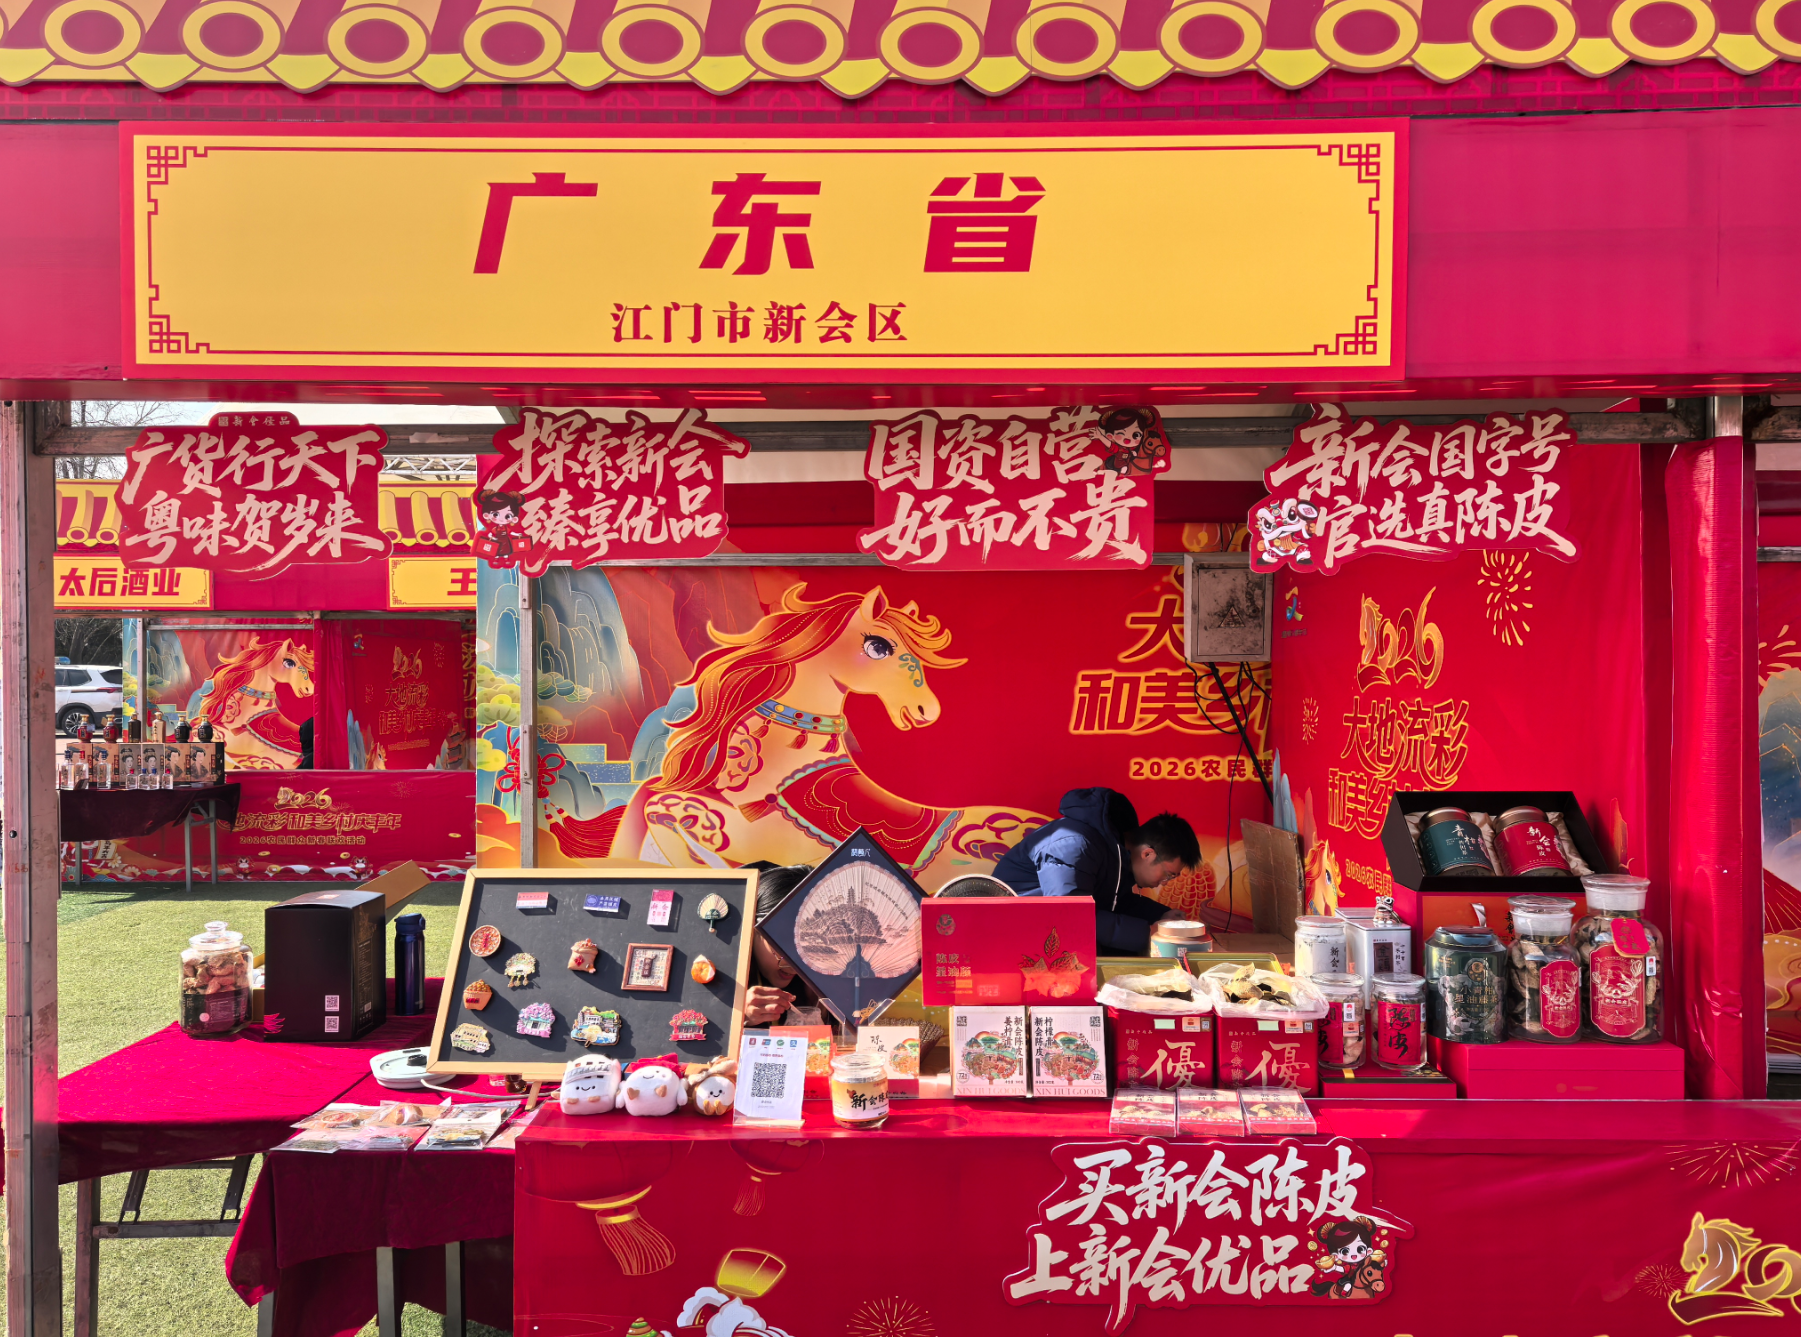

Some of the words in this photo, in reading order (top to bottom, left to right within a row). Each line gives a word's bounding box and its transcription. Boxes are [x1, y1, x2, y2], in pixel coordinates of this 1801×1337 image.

[473, 172, 1046, 275] 广东省
[611, 300, 908, 344] 江门市新会区
[121, 430, 381, 504] 广货行天下
[486, 409, 746, 497] 探索新会
[868, 405, 1104, 493] 国资自营
[1268, 402, 1571, 502] 新会国字号
[126, 490, 385, 572] 粤味贺岁来
[520, 484, 722, 572] 臻享优品
[860, 470, 1148, 565] 好而不贵
[1316, 475, 1576, 568] 官选真陈皮
[58, 567, 182, 596] 太后酒业
[1341, 696, 1469, 790] 大地流彩
[224, 812, 402, 835] 地流彩和美乡村庆丰年
[274, 786, 332, 810] 2026
[1328, 768, 1400, 840] 和美乡
[1330, 946, 1340, 972] 新会
[1014, 1016, 1024, 1057] 新会陈皮
[1034, 1016, 1044, 1057] 新会陈皮
[994, 1087, 1026, 1095] GOODS
[1035, 1087, 1052, 1095] XIN
[1054, 1087, 1071, 1095] HUI
[1072, 1087, 1106, 1095] GOODS
[1046, 1144, 1406, 1235] 买新会陈皮
[1010, 1223, 1315, 1331] 上新会优品
